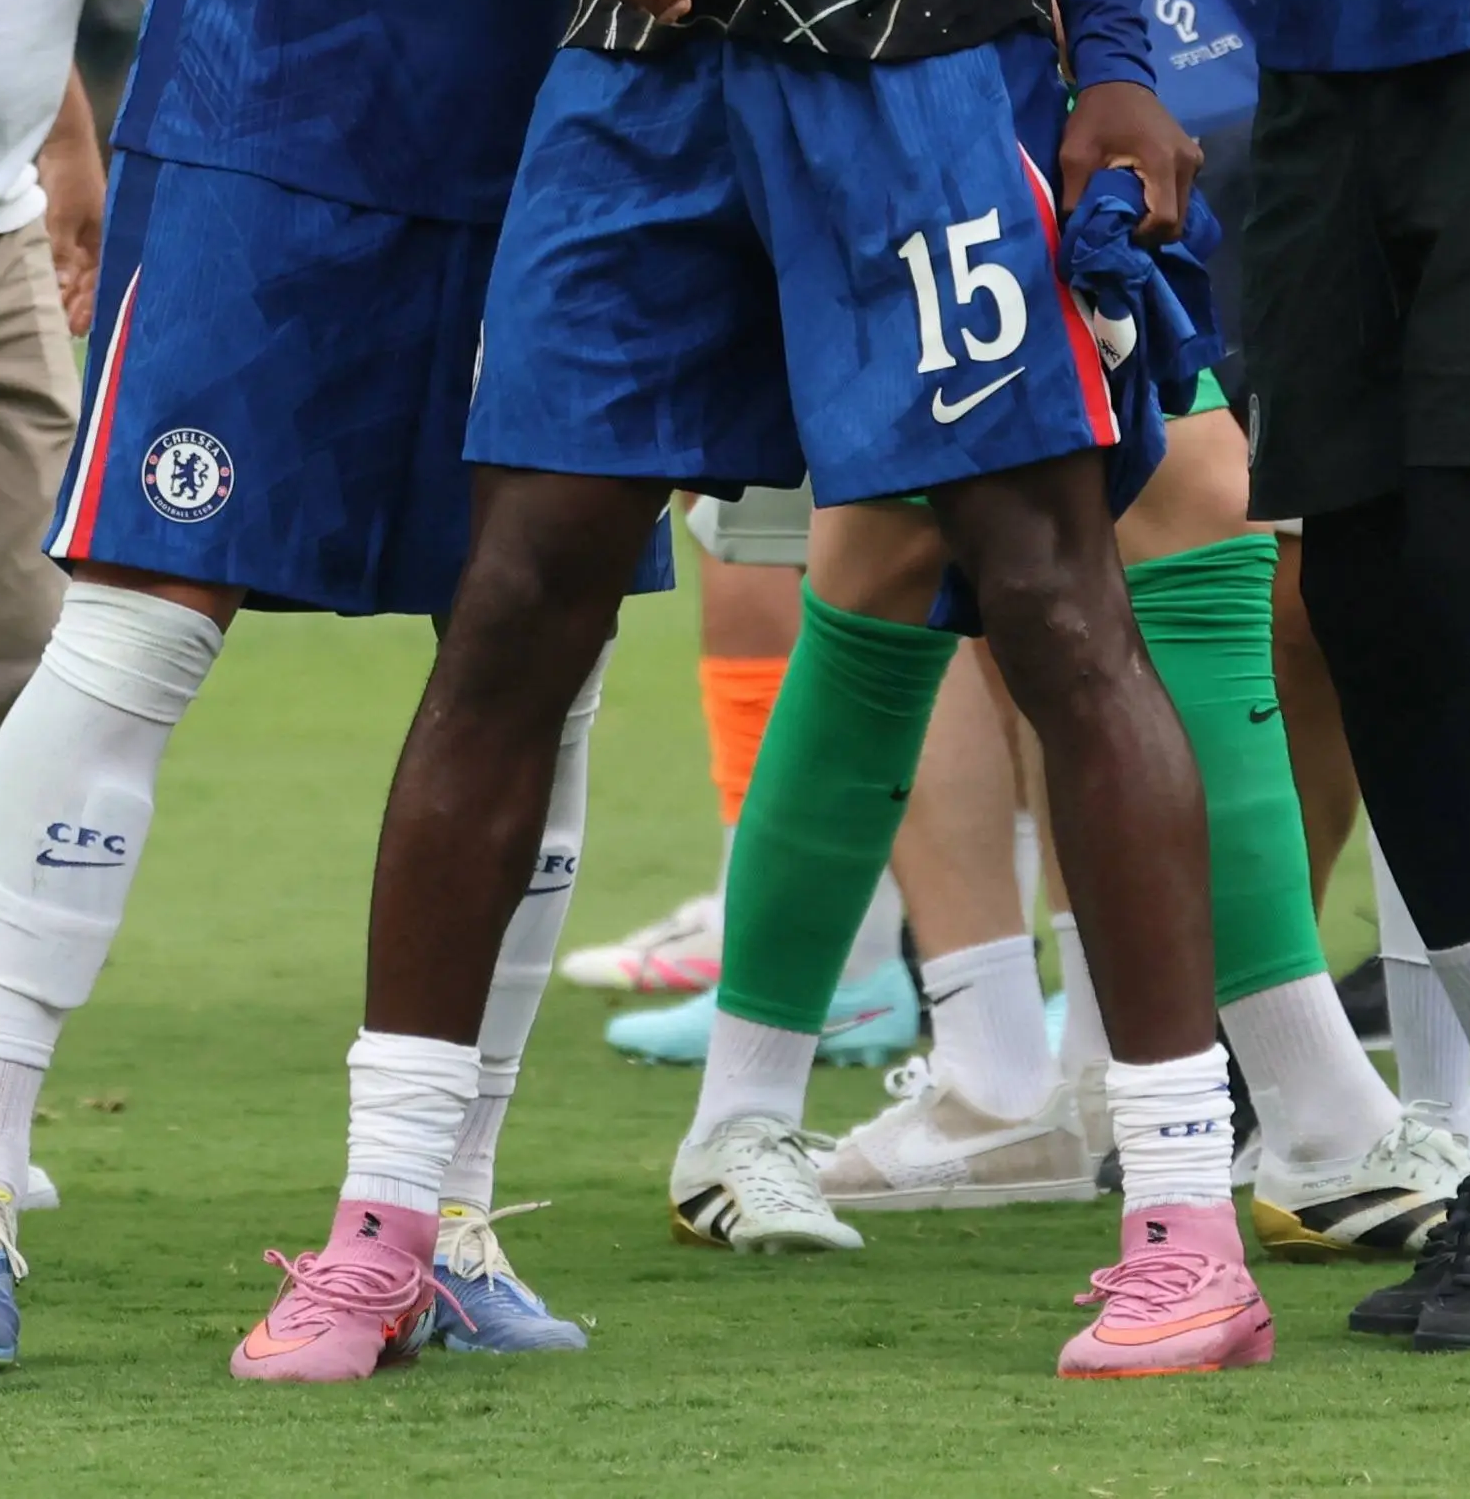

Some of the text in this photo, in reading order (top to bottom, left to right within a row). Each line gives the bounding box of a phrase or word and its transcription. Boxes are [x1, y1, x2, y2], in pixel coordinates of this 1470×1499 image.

[897, 208, 1028, 373] 15
[162, 432, 221, 457] CHELSEA
[153, 495, 214, 518] FOOTBALL CLUB
[46, 822, 126, 856] CFC
